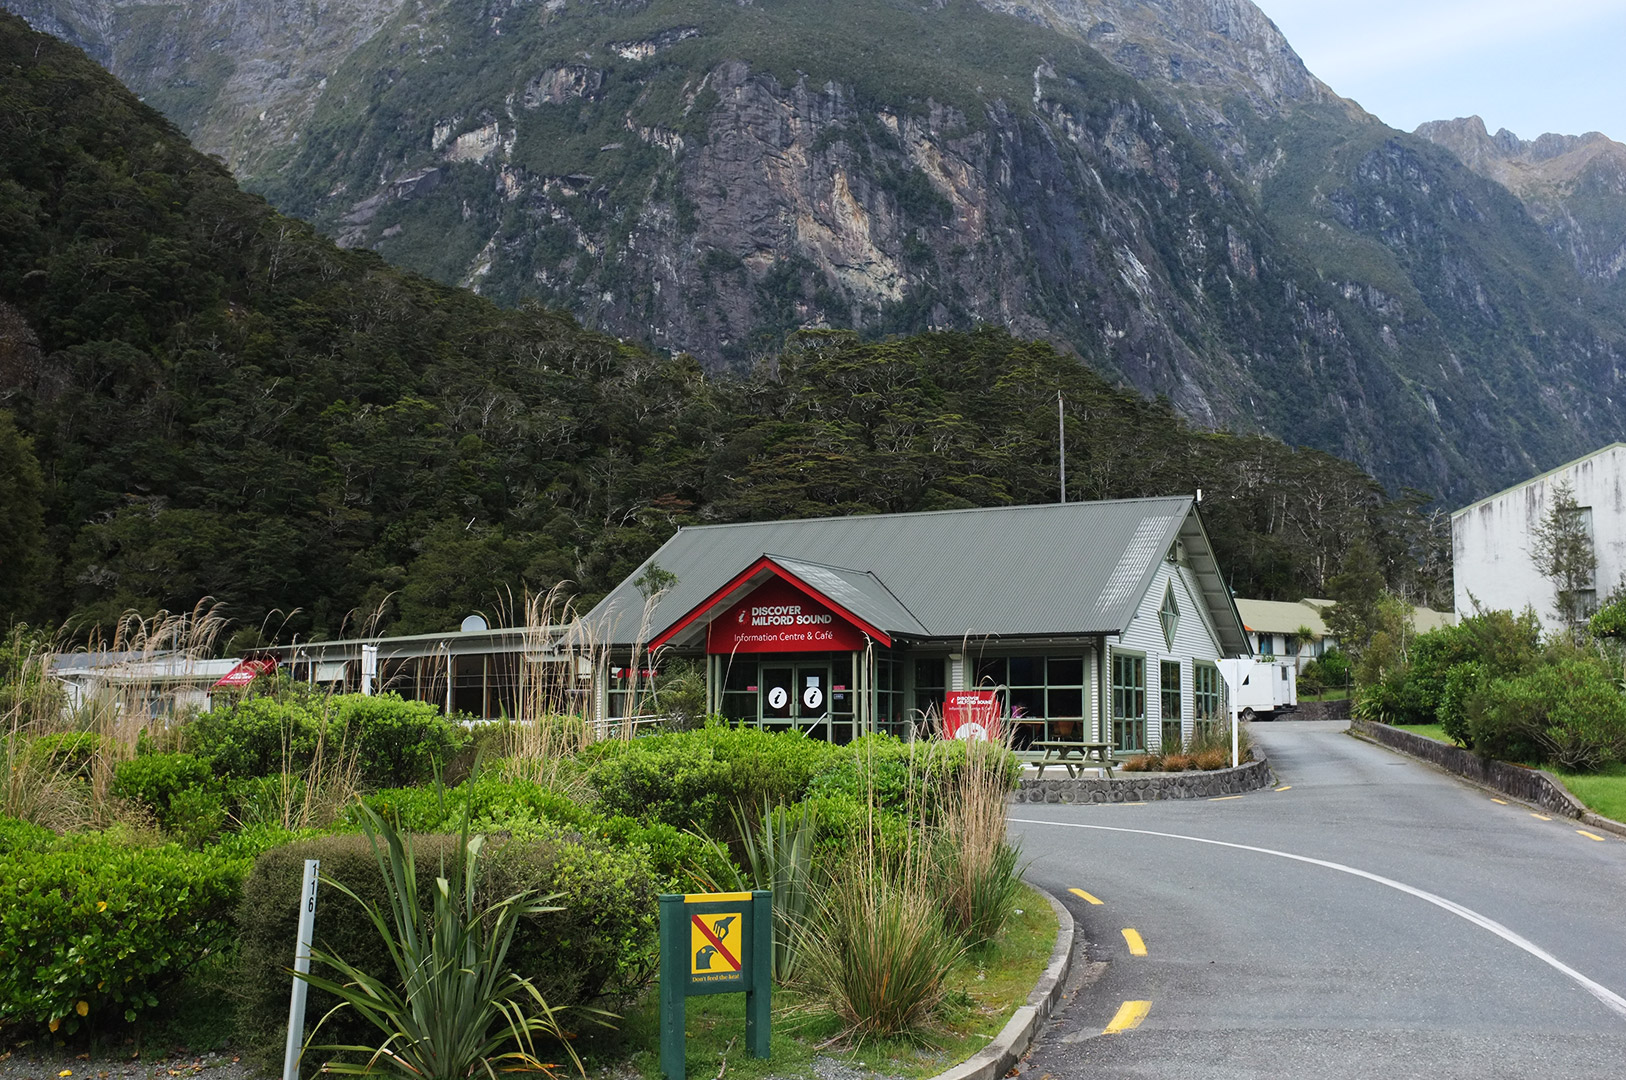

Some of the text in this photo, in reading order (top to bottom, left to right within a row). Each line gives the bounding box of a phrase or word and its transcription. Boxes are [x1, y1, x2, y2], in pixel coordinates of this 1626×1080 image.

[751, 606, 801, 616] DISCOVER
[751, 615, 832, 626] MILFORD SOUND
[734, 631, 833, 642] Information Centre & Café
